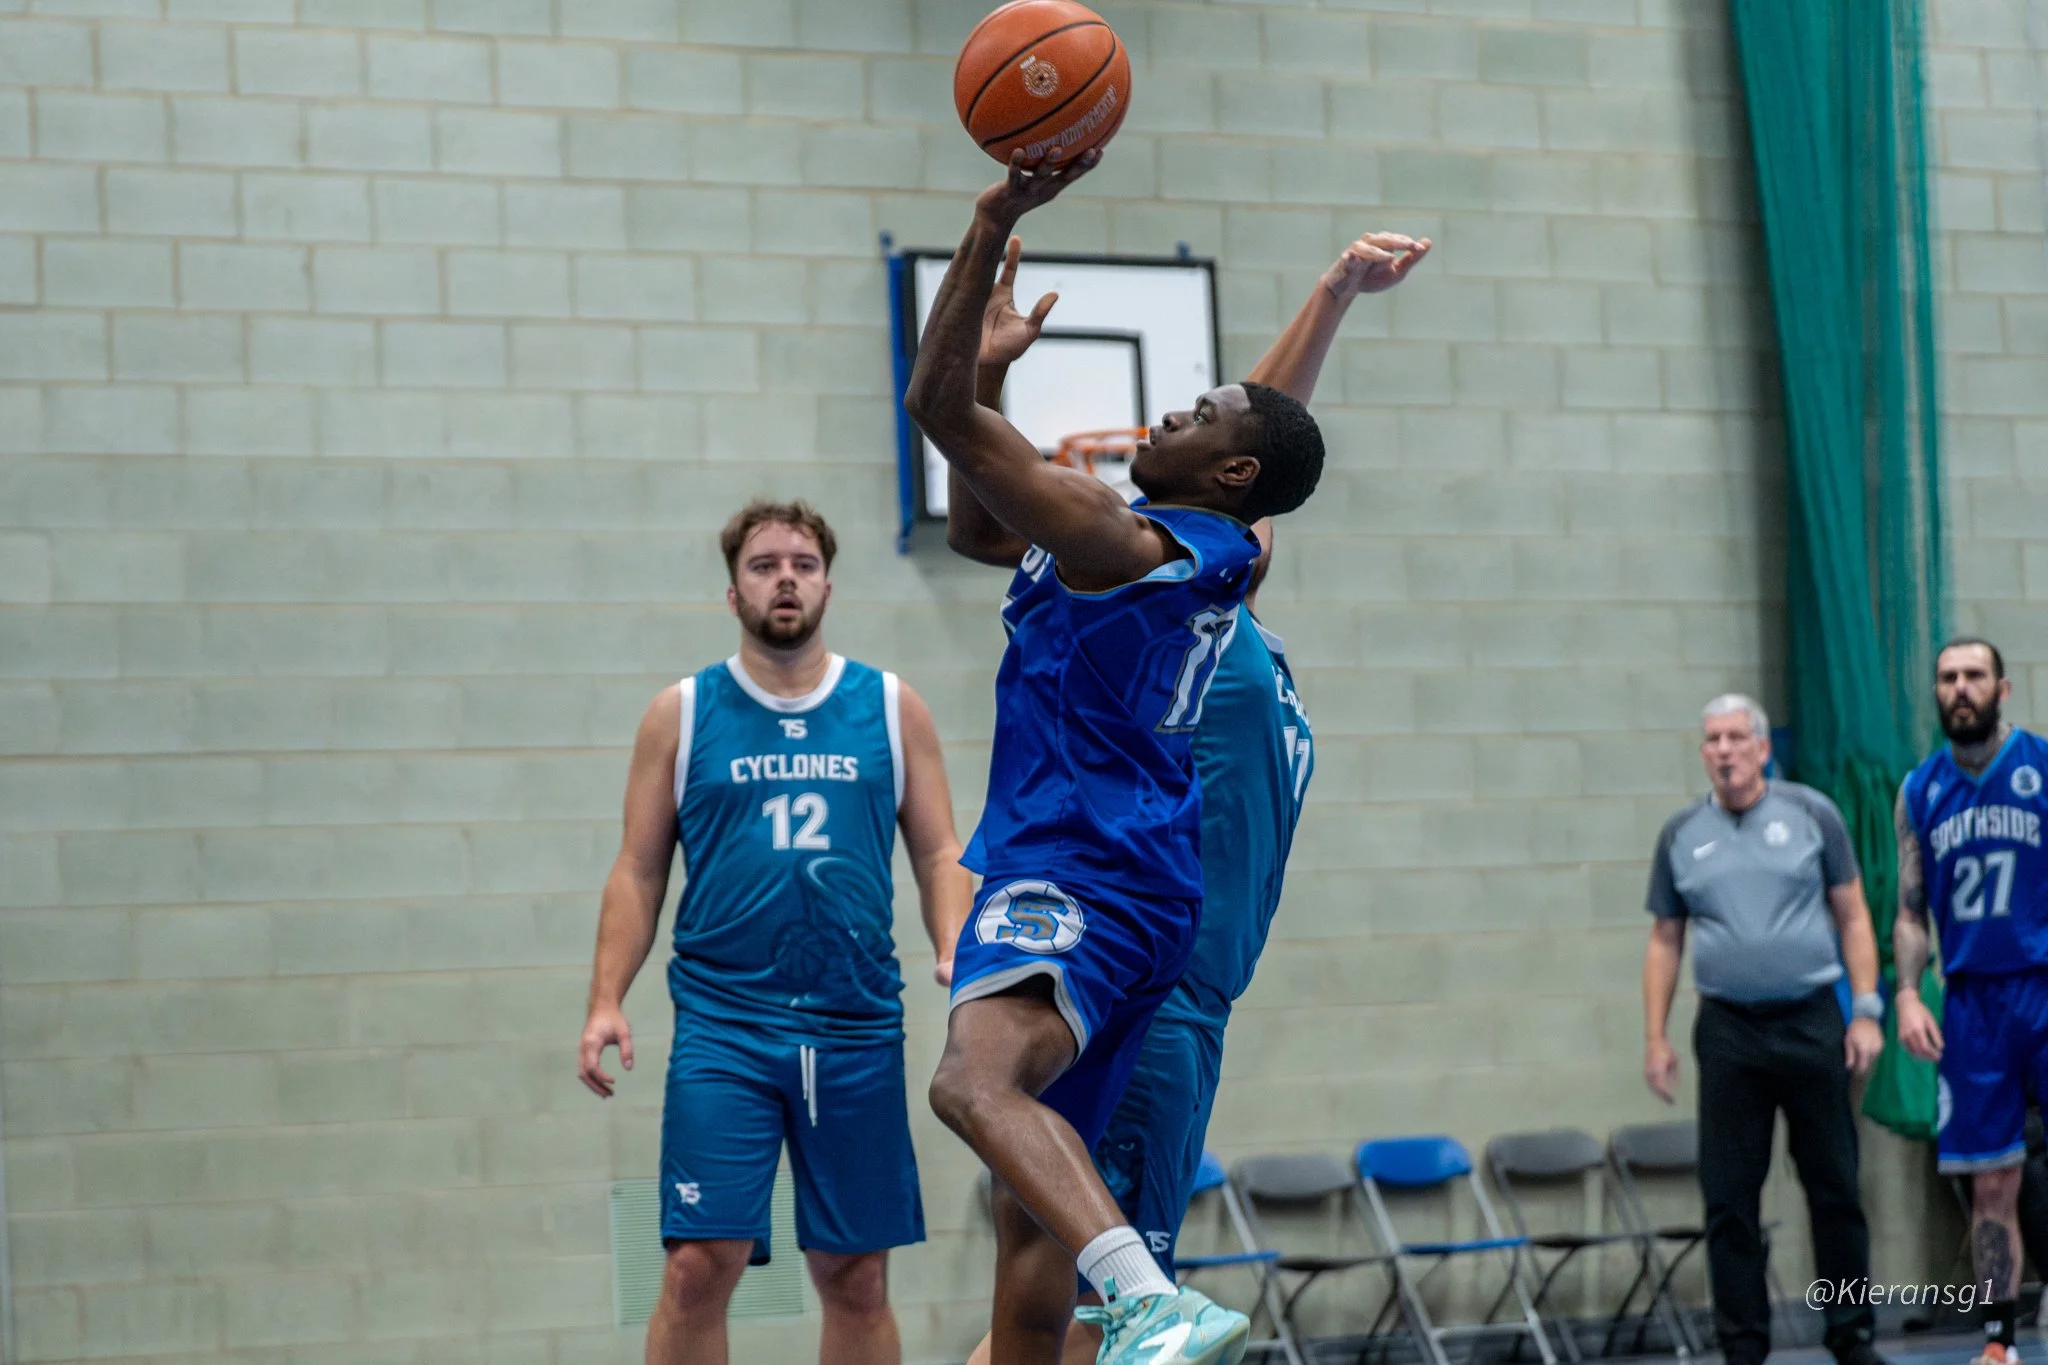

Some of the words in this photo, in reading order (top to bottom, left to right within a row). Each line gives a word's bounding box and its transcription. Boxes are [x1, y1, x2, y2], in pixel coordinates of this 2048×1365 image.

[730, 753, 858, 783] CYCLONES
[762, 792, 830, 850] 12
[1929, 804, 2041, 862] SOUTHSIDE
[1953, 850, 2016, 922] 27
